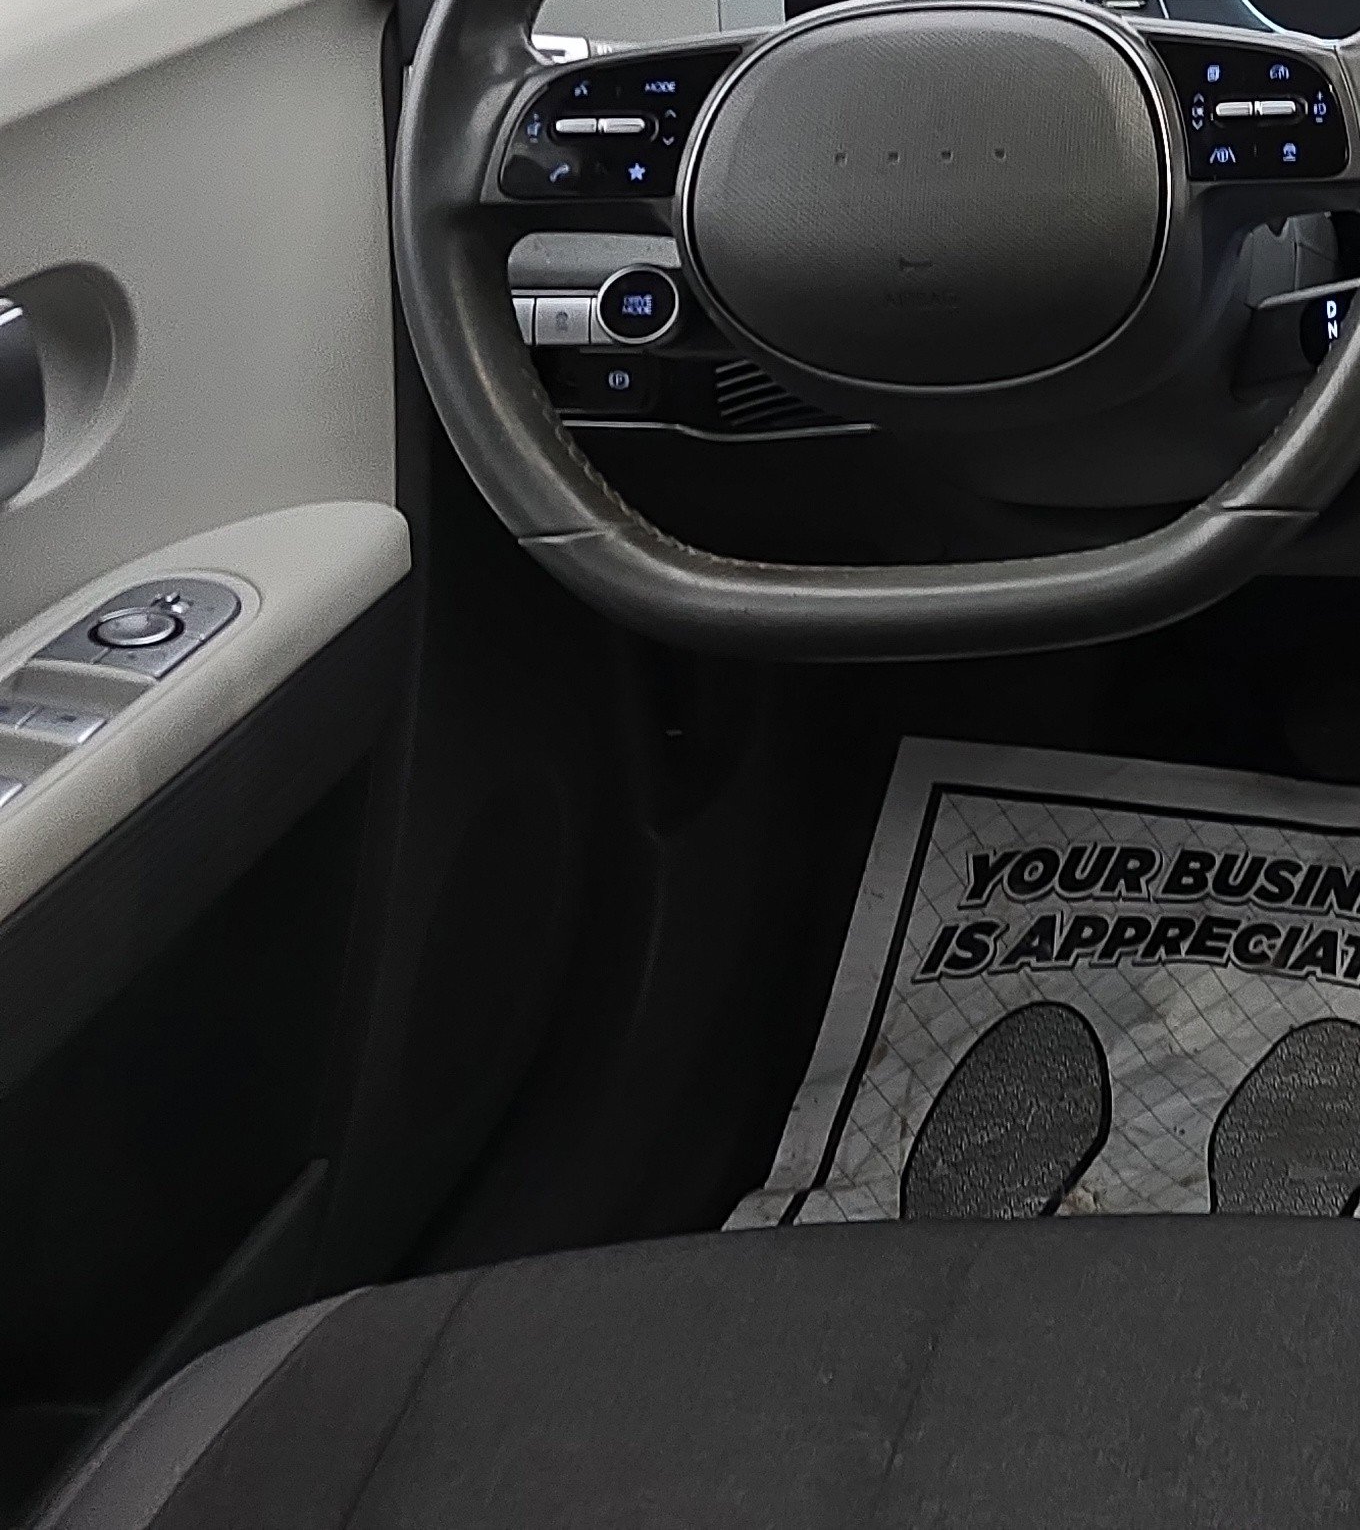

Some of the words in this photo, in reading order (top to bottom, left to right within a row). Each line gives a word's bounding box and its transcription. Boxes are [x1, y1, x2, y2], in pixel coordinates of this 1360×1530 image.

[644, 80, 677, 94] MODE
[1326, 300, 1337, 319] D
[1327, 319, 1338, 340] N
[960, 844, 1163, 907] YOUR
[911, 918, 1007, 983] IS
